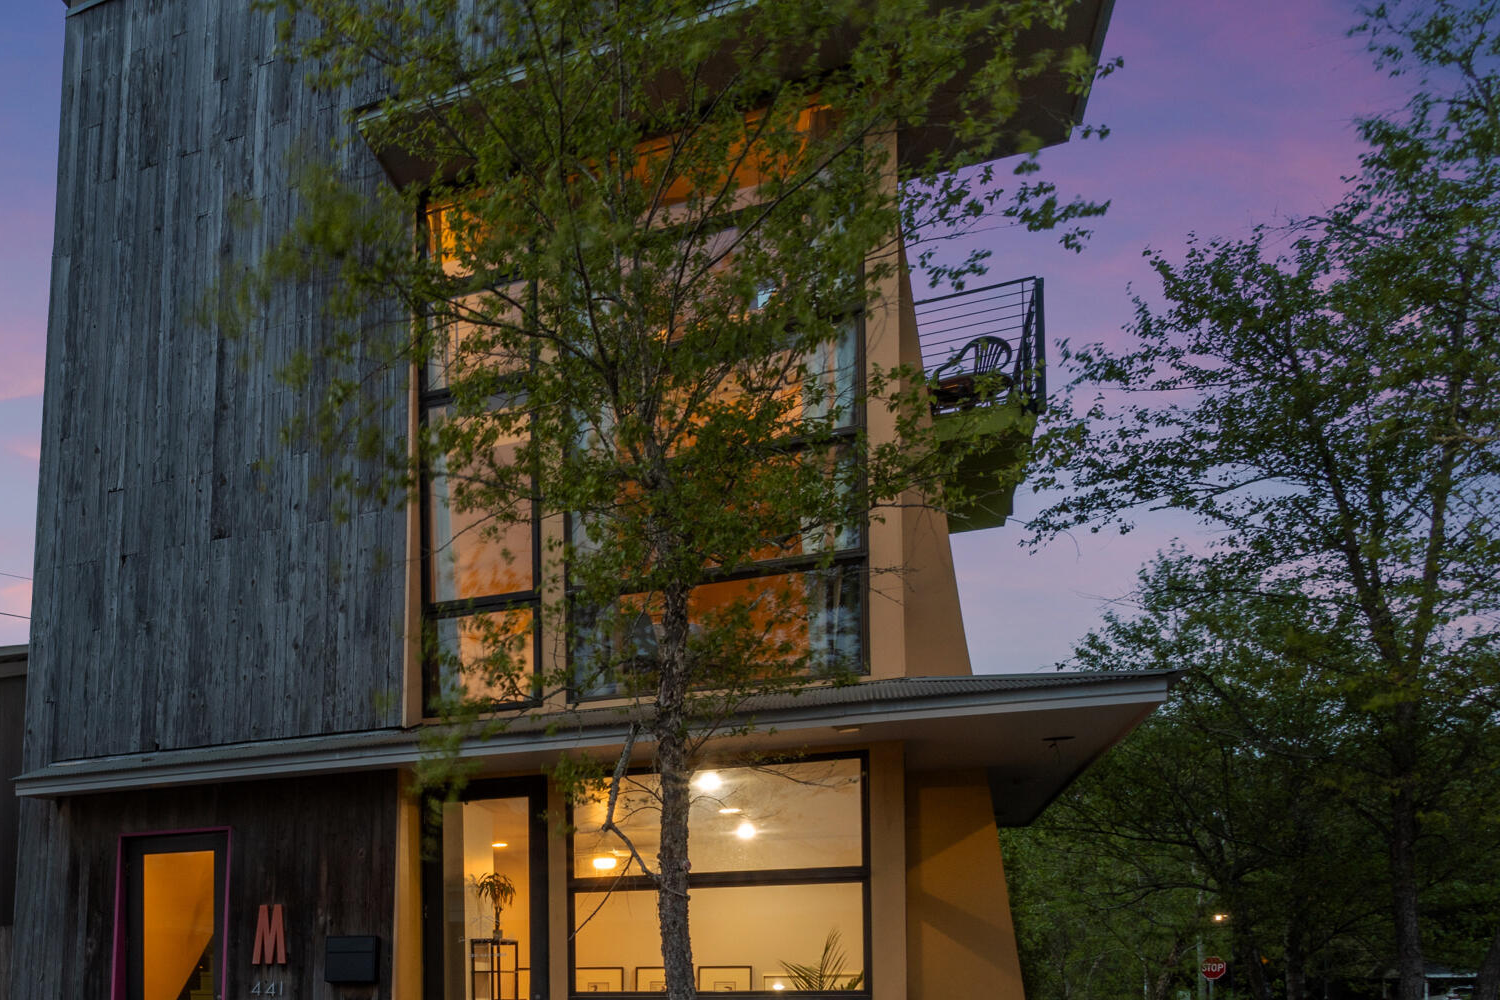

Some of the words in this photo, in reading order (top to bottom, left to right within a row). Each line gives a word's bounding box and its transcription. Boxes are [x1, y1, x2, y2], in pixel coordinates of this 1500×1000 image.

[252, 904, 286, 965] M
[1202, 963, 1224, 972] STOP
[252, 981, 283, 996] 441
